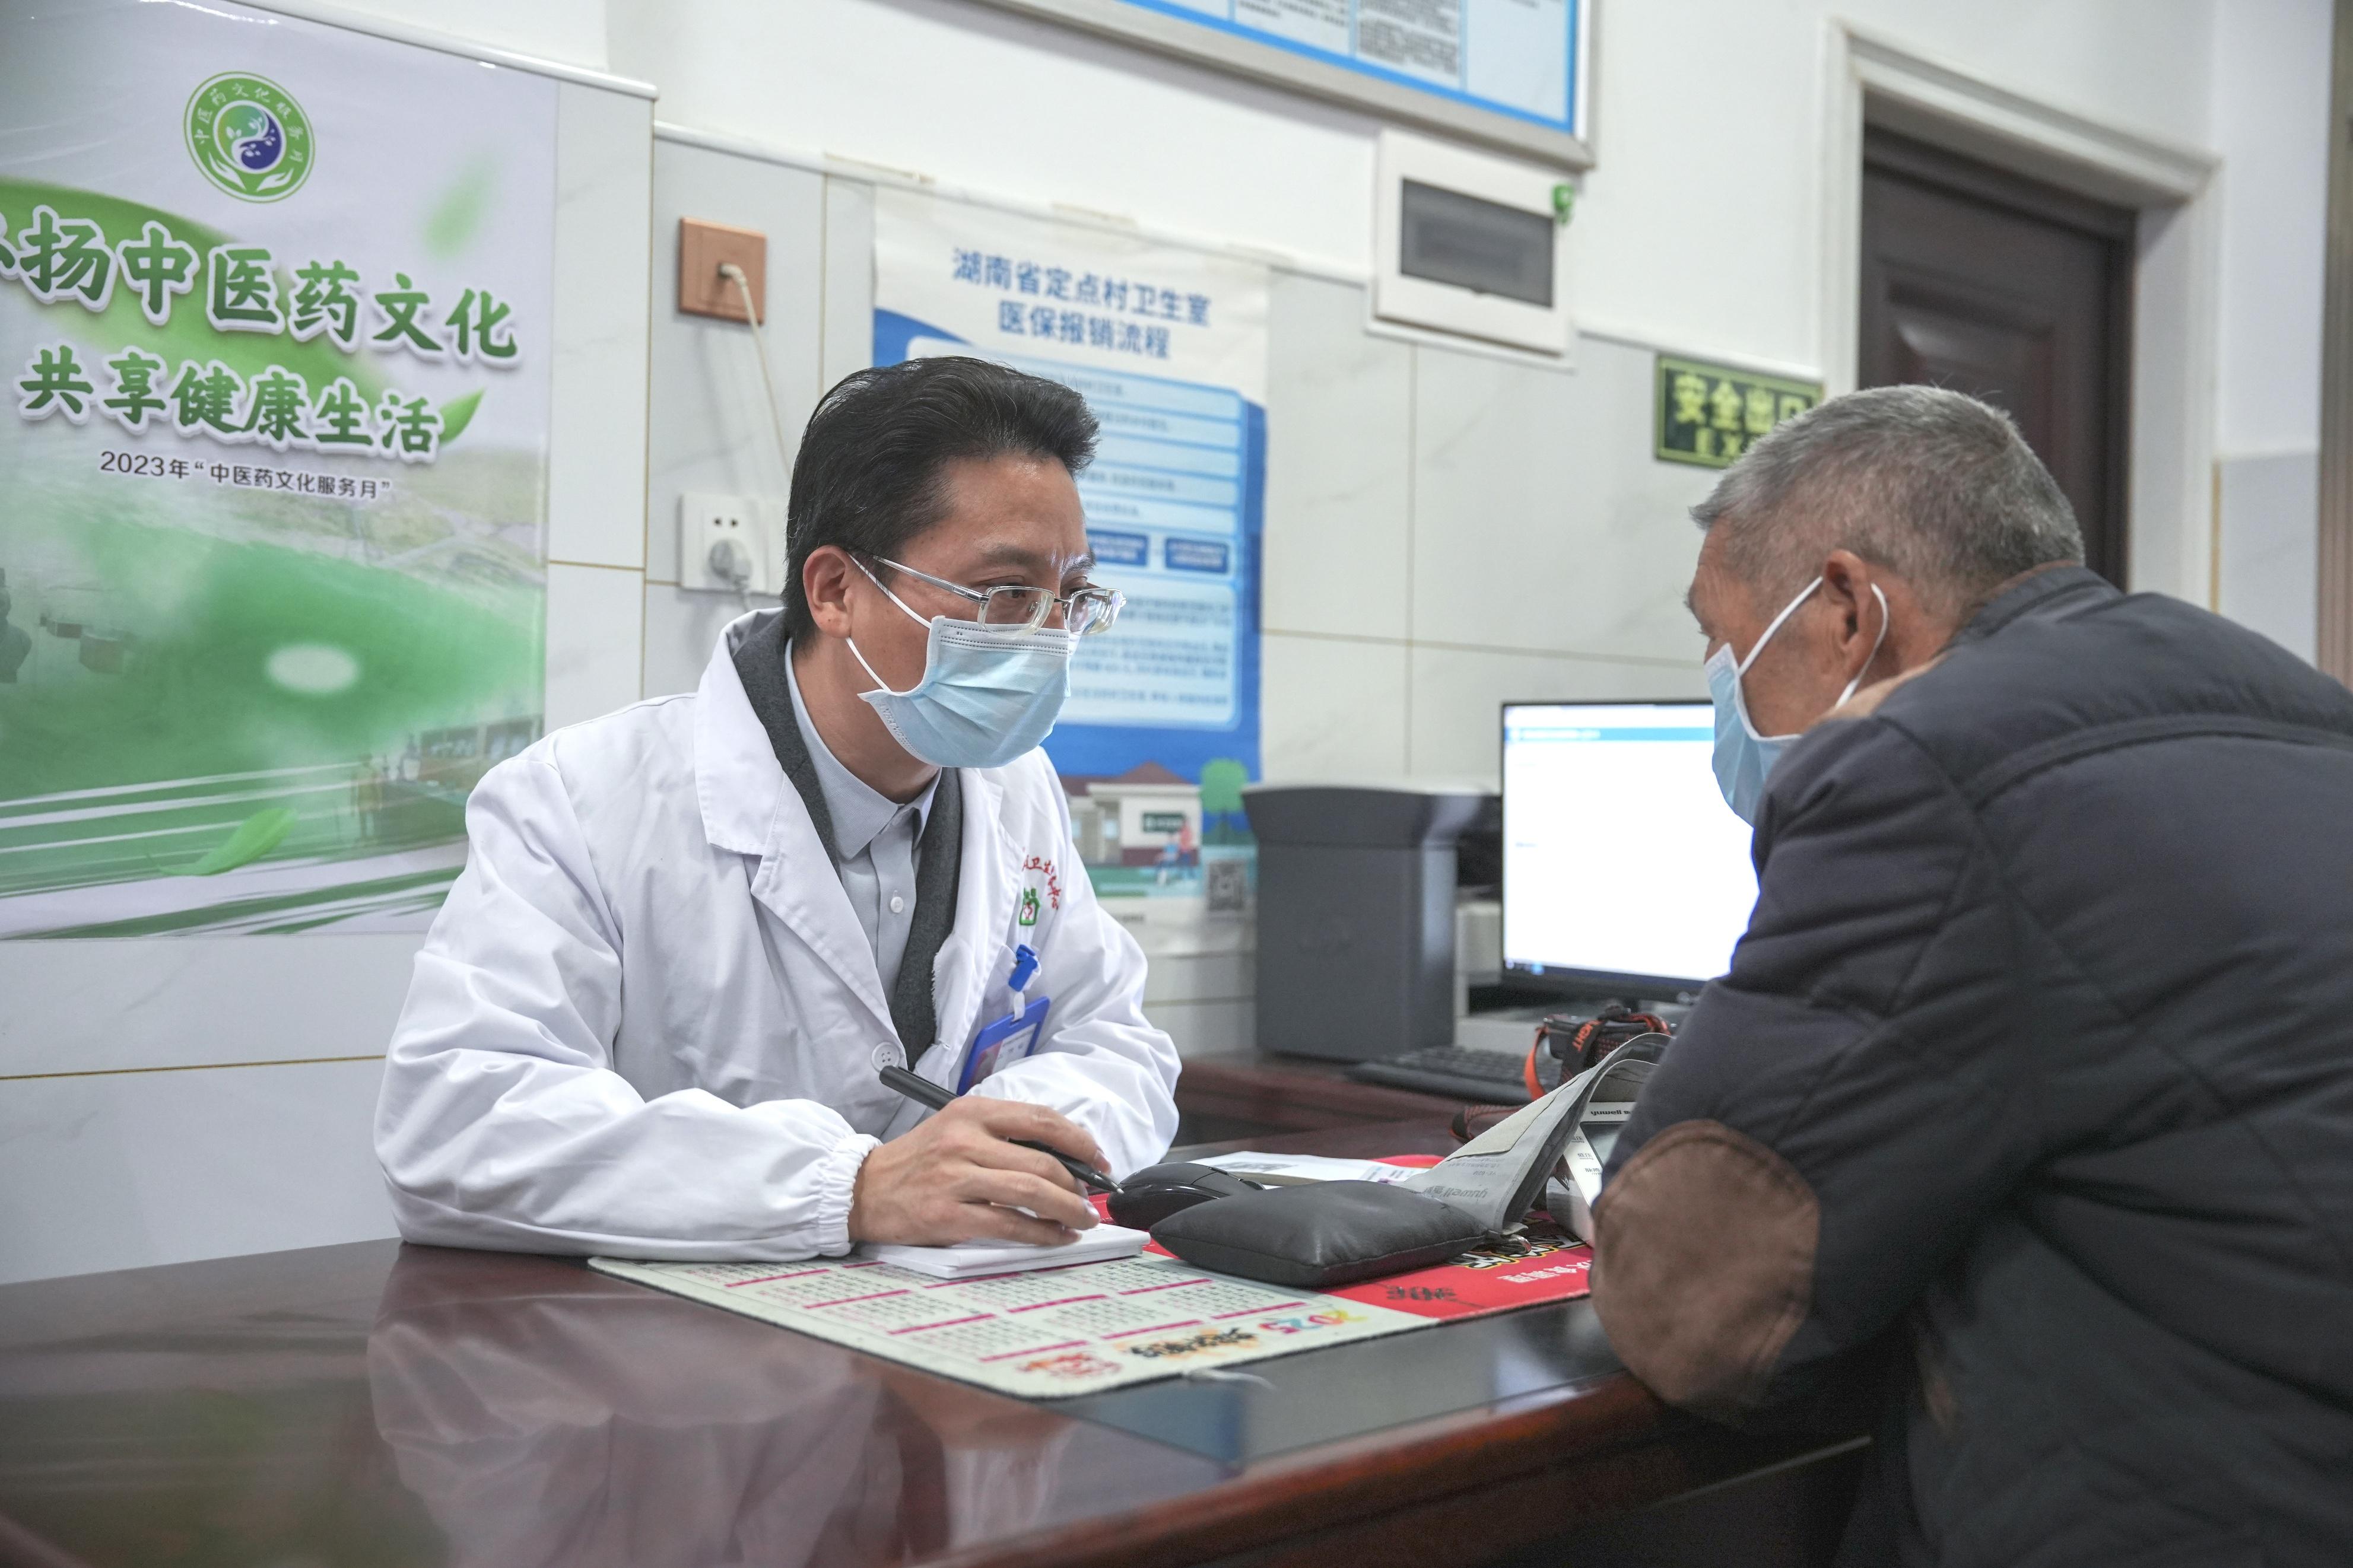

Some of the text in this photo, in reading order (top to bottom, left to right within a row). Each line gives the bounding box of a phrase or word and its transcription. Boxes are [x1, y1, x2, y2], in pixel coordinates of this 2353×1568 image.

[0, 211, 518, 359] 扬中医药文化
[951, 247, 1211, 327] 湖南省定点村卫生室
[998, 299, 1171, 358] 医保报销流程
[20, 345, 439, 454] 共享健康生活
